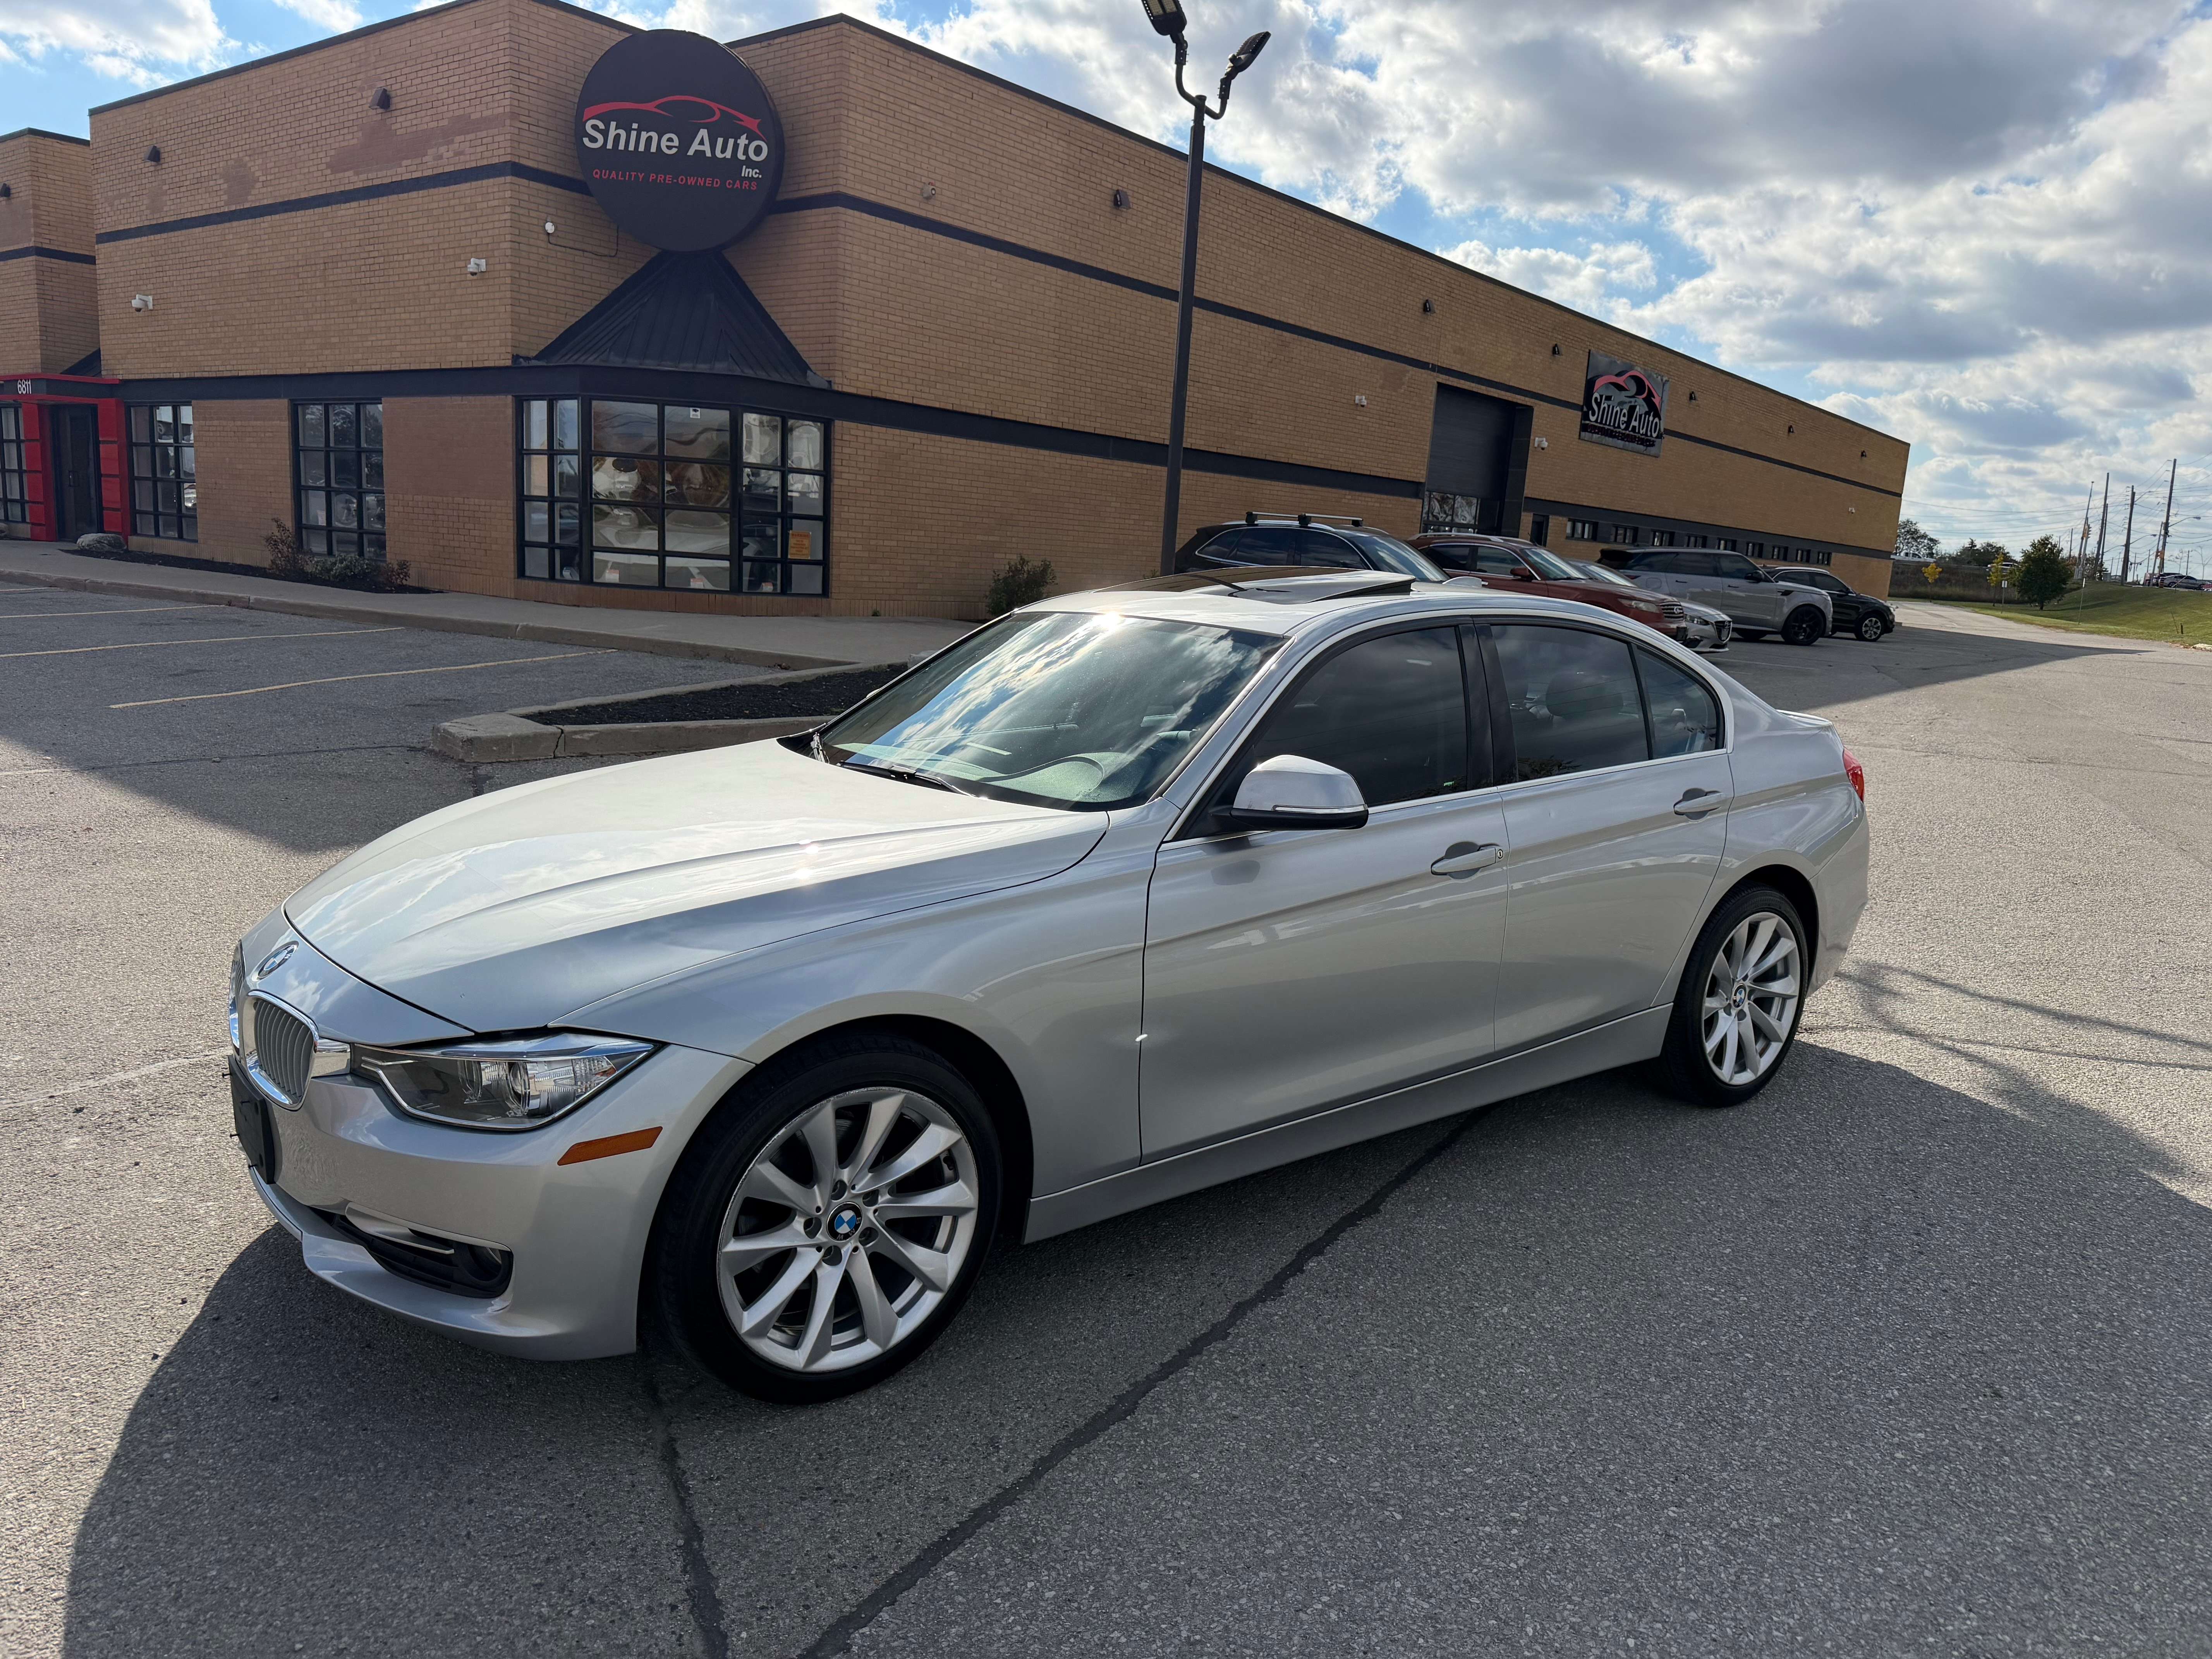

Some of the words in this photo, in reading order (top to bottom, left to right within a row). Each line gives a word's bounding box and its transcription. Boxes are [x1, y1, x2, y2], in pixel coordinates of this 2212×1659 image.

[582, 119, 679, 155] Shine
[687, 128, 768, 161] Auto
[592, 169, 645, 182] QUALITY
[649, 173, 721, 187] PRE-OWNED
[726, 179, 757, 190] CARS
[741, 165, 762, 178] Inc.
[17, 379, 31, 394] 6811
[1589, 392, 1628, 430] Shine
[1630, 405, 1659, 438] Auto
[836, 1217, 861, 1240] BMW
